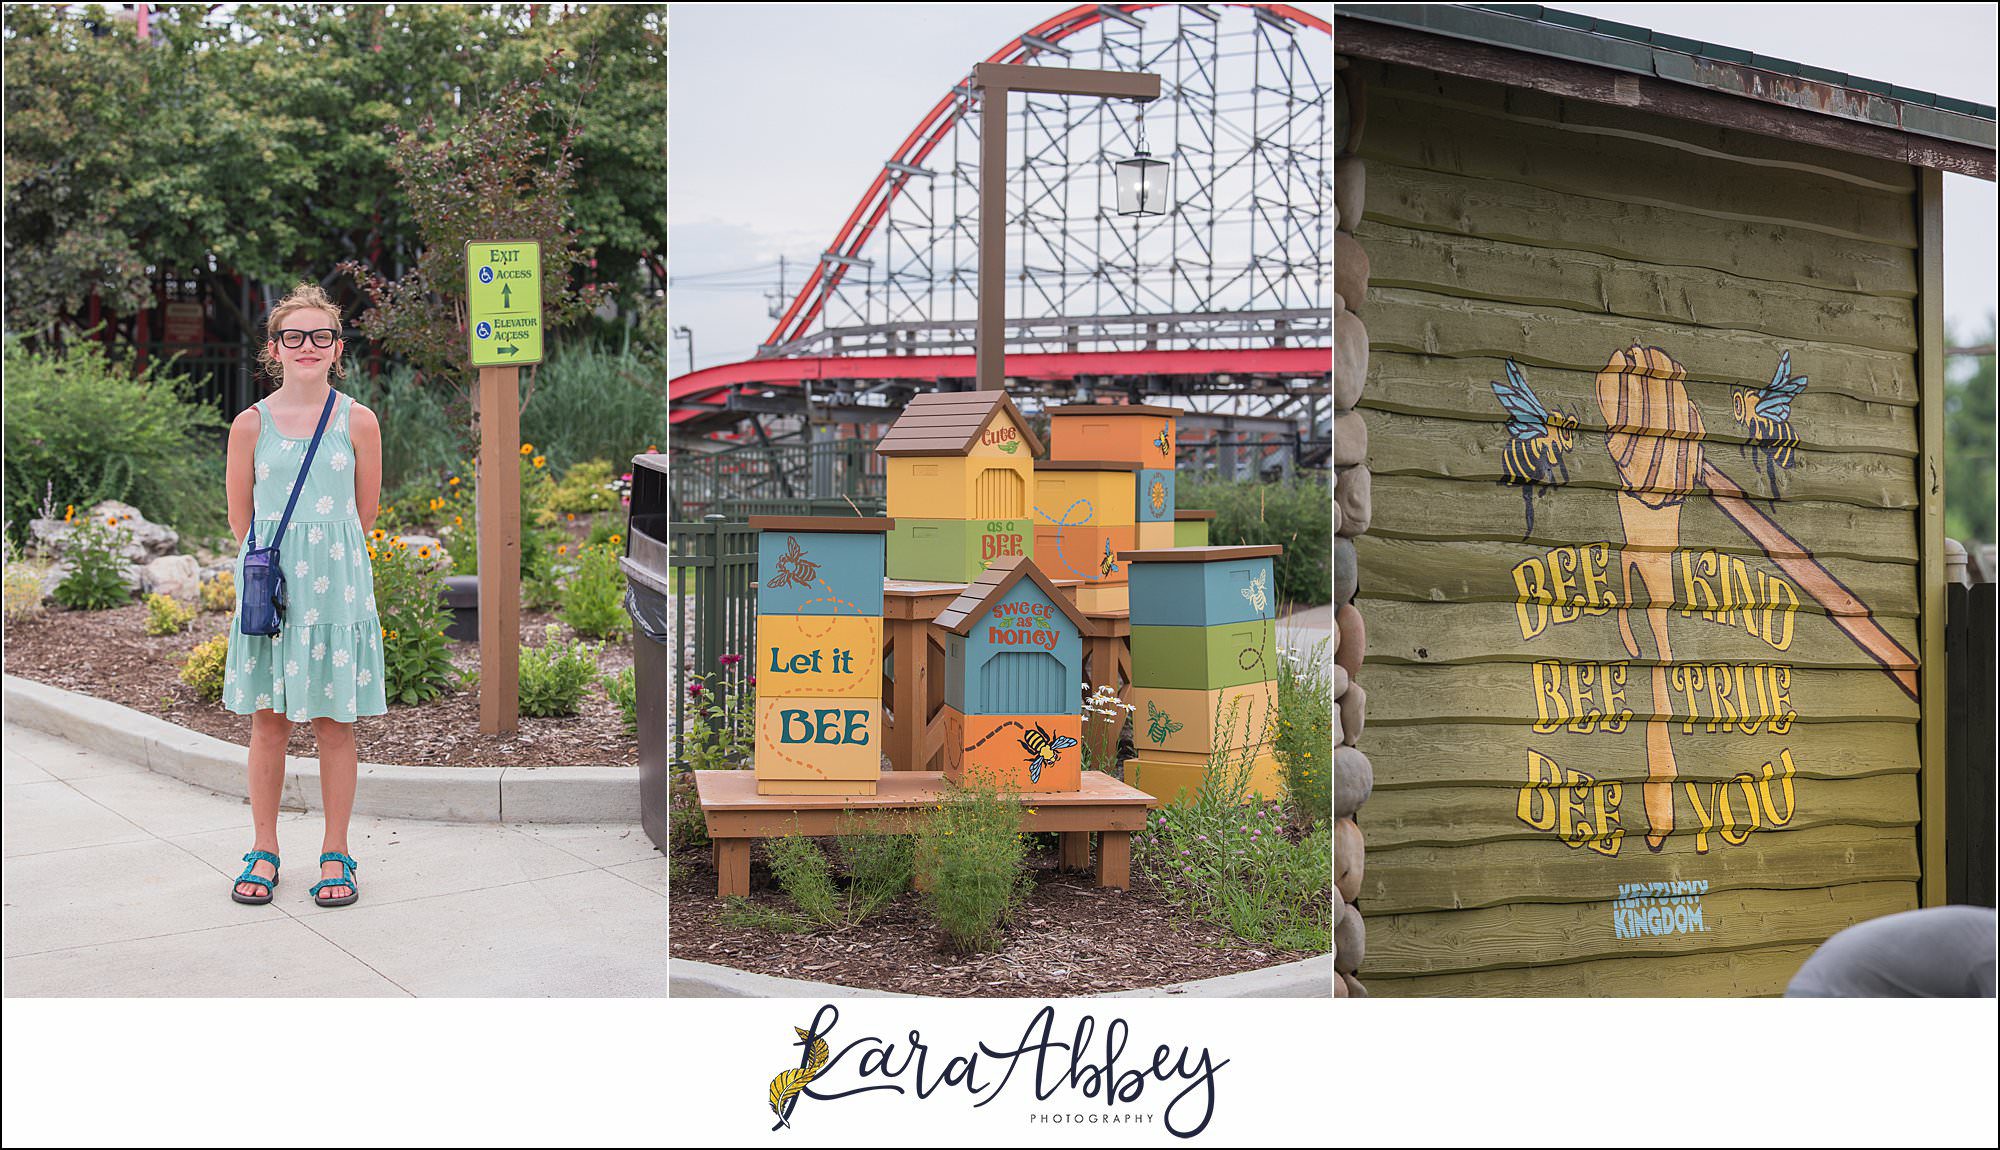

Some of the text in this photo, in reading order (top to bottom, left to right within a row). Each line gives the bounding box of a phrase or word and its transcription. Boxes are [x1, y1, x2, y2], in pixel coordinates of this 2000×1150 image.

[489, 249, 520, 263] EXIT
[496, 270, 532, 280] ACCESS
[494, 318, 537, 329] ELEVATOR
[494, 331, 530, 341] ACCESS
[981, 426, 1017, 446] Cute
[987, 521, 1015, 532] as a
[982, 533, 1024, 560] BEE
[1511, 540, 1801, 652] BEE KIND
[992, 601, 1055, 620] sweet
[1016, 616, 1033, 628] as
[989, 626, 1061, 651] honey
[769, 647, 854, 674] Let it
[1531, 660, 1799, 736] BEE TRUE
[780, 709, 870, 746] BEE
[1515, 748, 1797, 858] BEE YOU
[1613, 880, 1709, 909] KENTUCKY
[1613, 903, 1705, 939] KINGDOM
